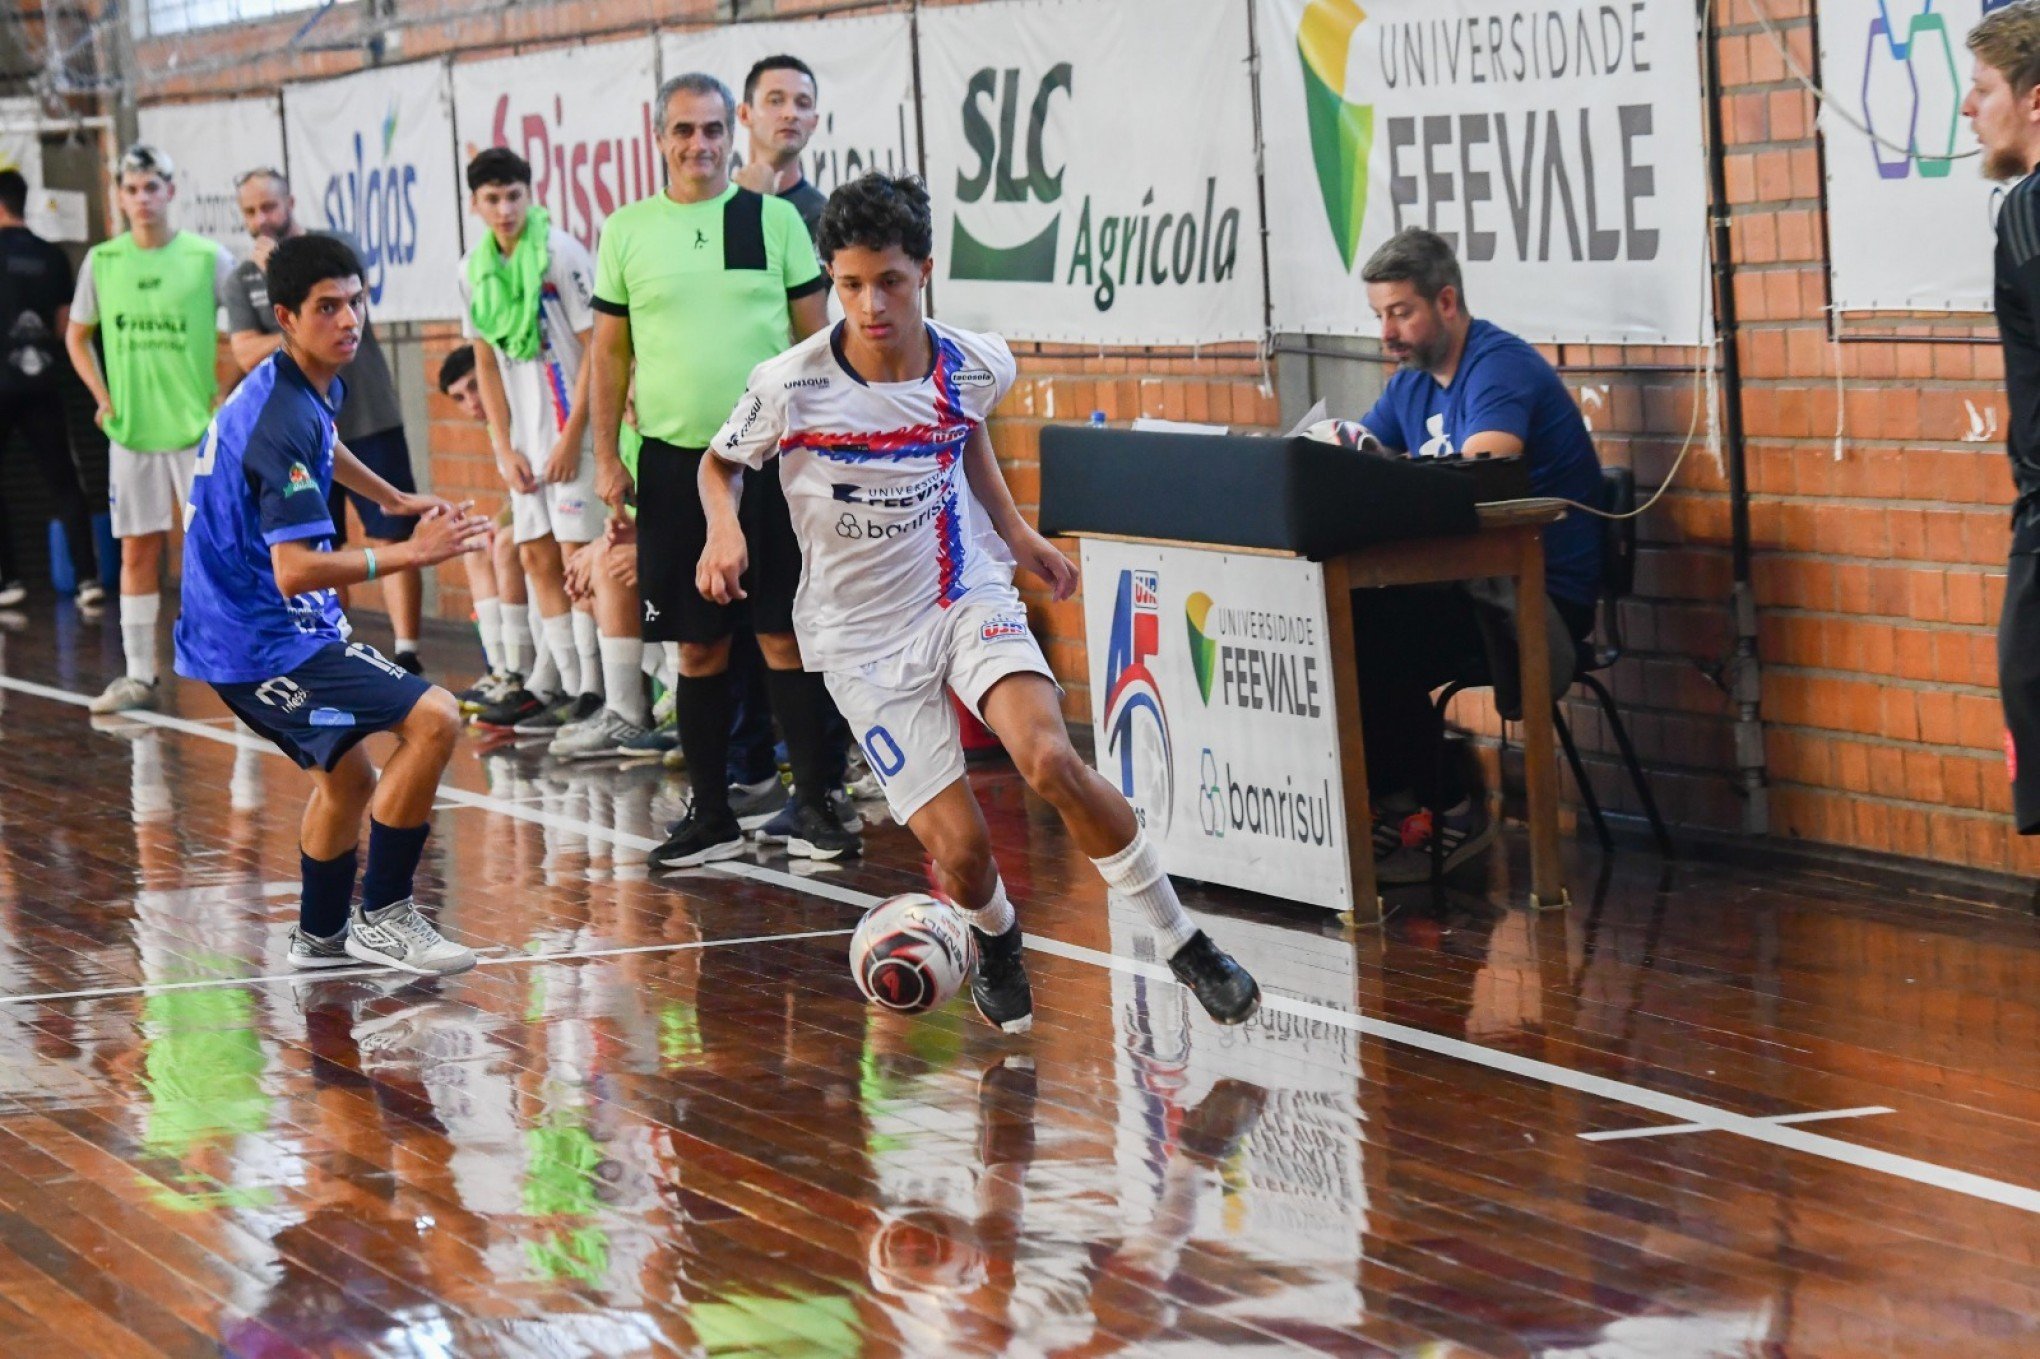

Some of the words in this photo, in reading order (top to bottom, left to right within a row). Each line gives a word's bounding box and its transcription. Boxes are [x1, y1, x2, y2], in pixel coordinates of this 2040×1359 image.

[1380, 2, 1651, 88] UNIVERSIDADE
[955, 62, 1072, 204] SLC
[1387, 103, 1660, 262] FEEVALE
[1067, 177, 1240, 312] Agrícola
[1218, 607, 1315, 646] UNIVERSIDADE
[1221, 645, 1321, 719] FEEVALE
[1226, 762, 1333, 848] banrisul
